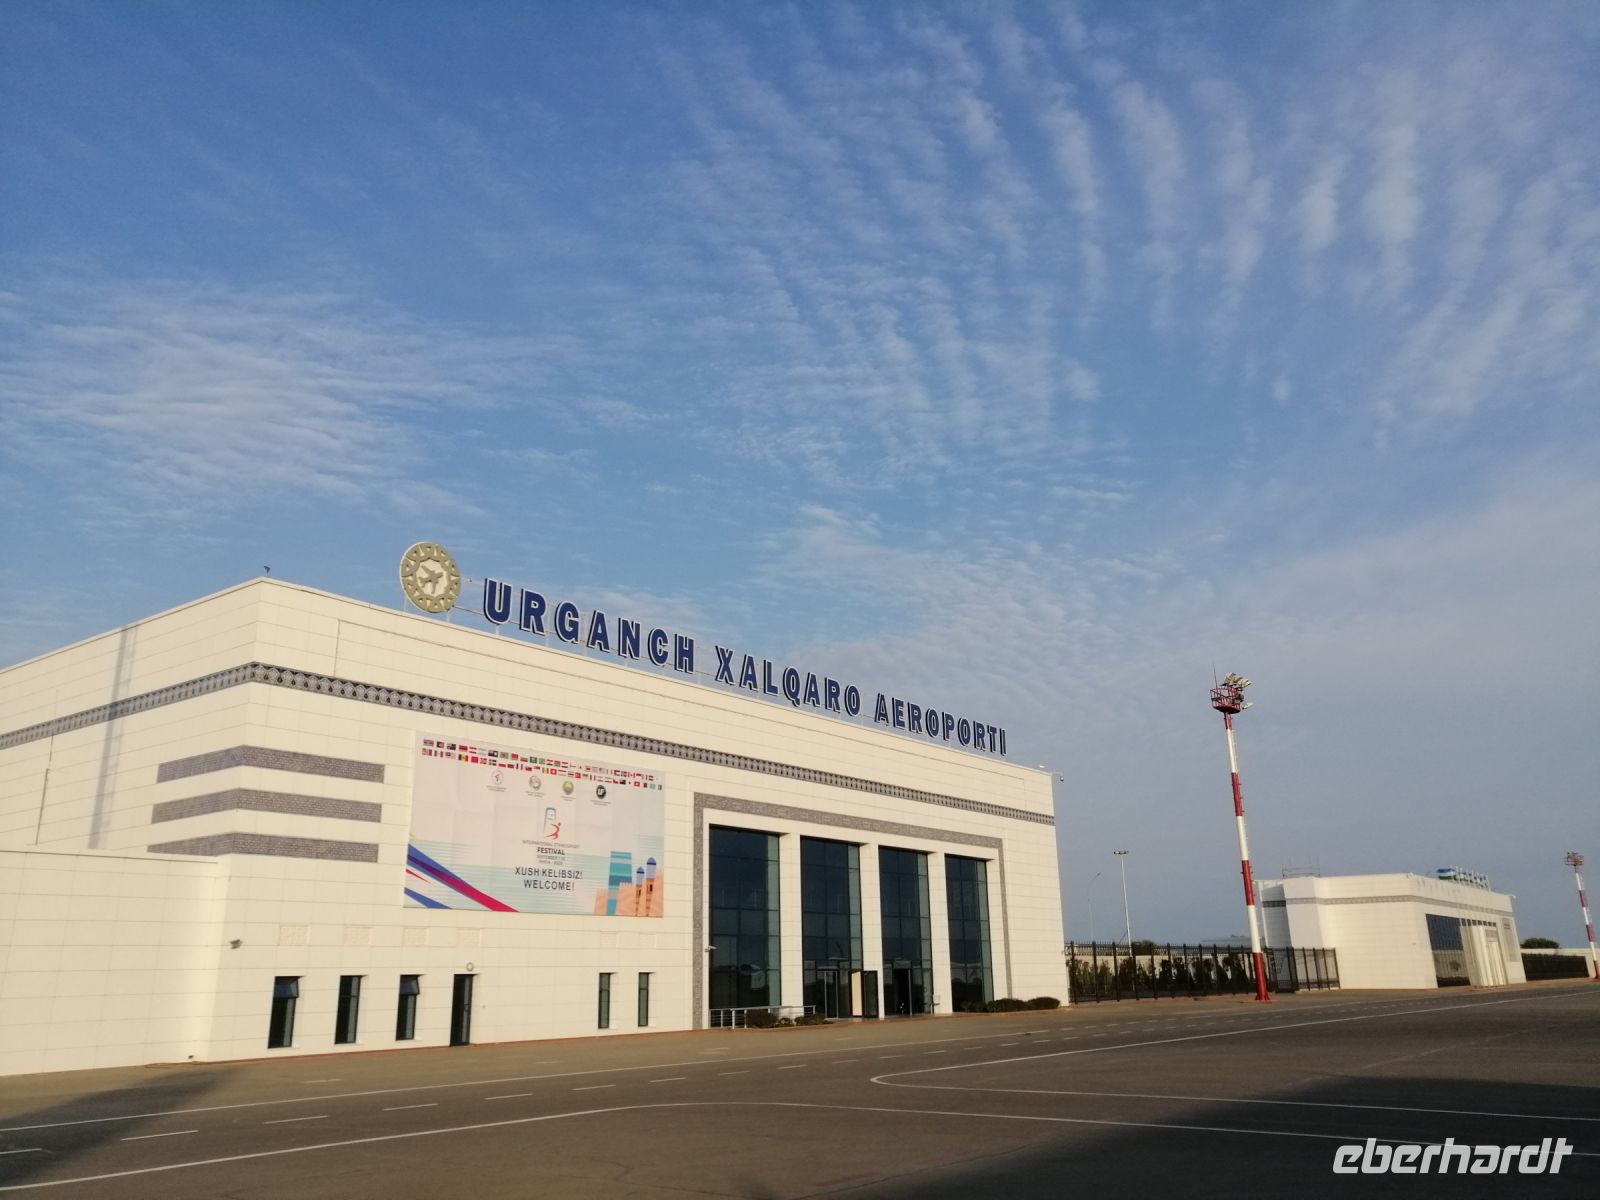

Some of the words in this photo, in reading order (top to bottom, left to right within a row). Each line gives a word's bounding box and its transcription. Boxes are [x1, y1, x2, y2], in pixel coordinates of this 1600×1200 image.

[483, 577, 696, 674] URGANCH
[715, 645, 861, 717] XALQARO
[874, 692, 1007, 756] AEROPORTI
[536, 846, 566, 856] FESTIVAL
[514, 866, 540, 877] XUSH
[541, 868, 583, 880] KELIBSIZ!
[523, 879, 575, 891] WELCOME!
